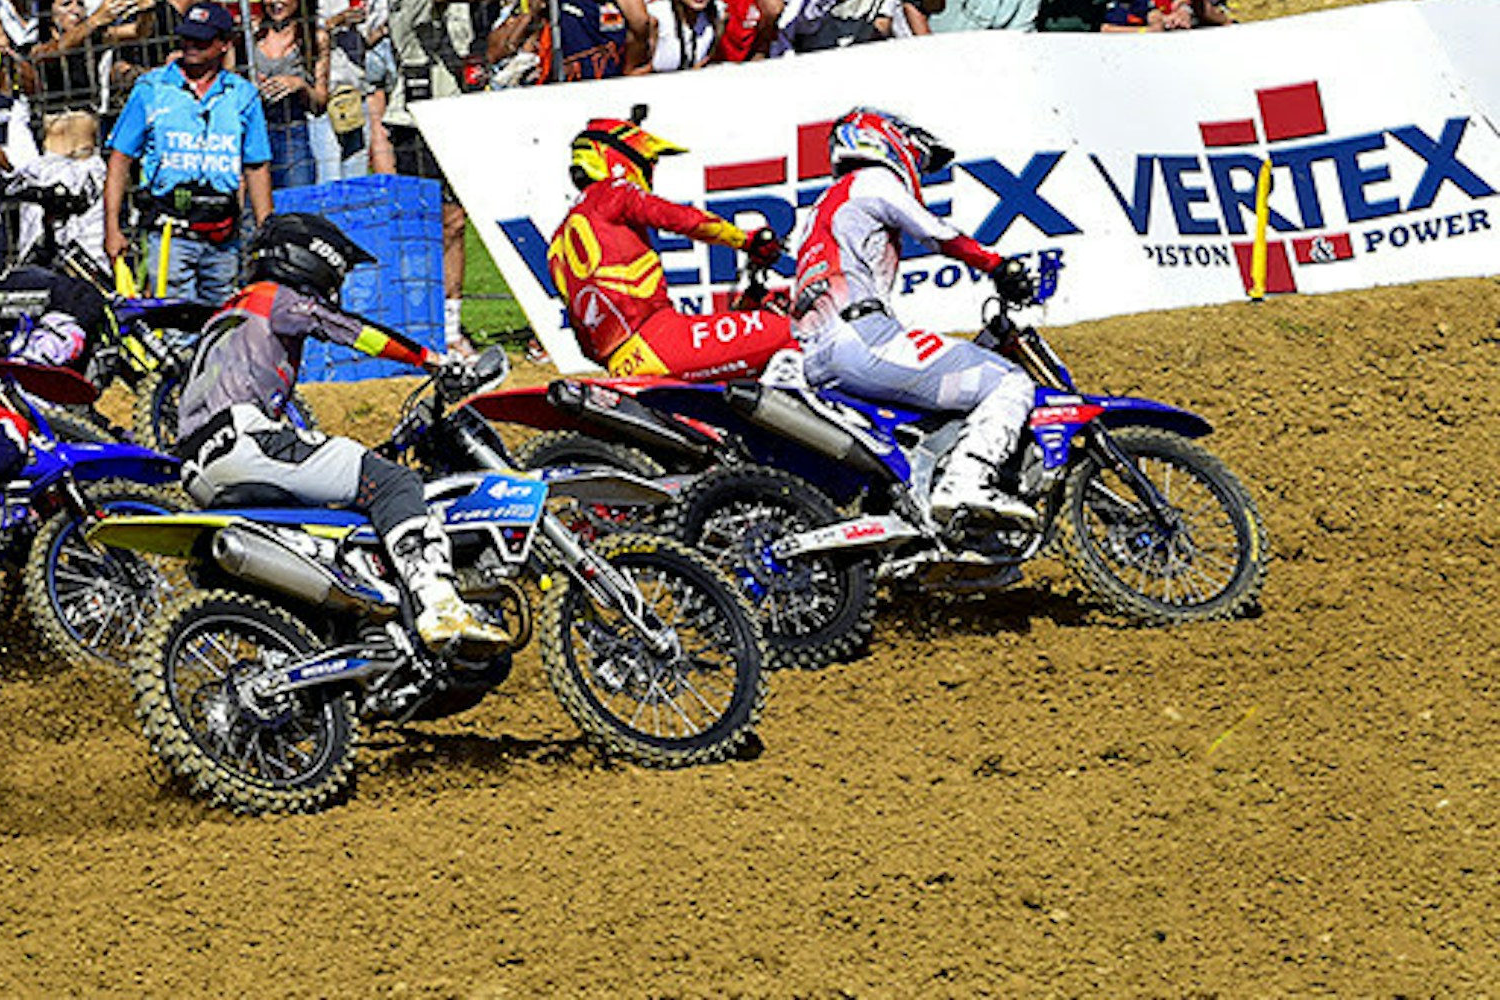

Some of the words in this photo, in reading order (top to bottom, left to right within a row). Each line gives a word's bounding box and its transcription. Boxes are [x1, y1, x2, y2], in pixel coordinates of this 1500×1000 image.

[164, 130, 238, 152] TRACK
[1088, 115, 1499, 236] VERTEX
[498, 149, 1083, 299] VERX
[1362, 208, 1492, 255] POWER
[690, 310, 764, 350] FOX
[612, 348, 646, 378] FOX
